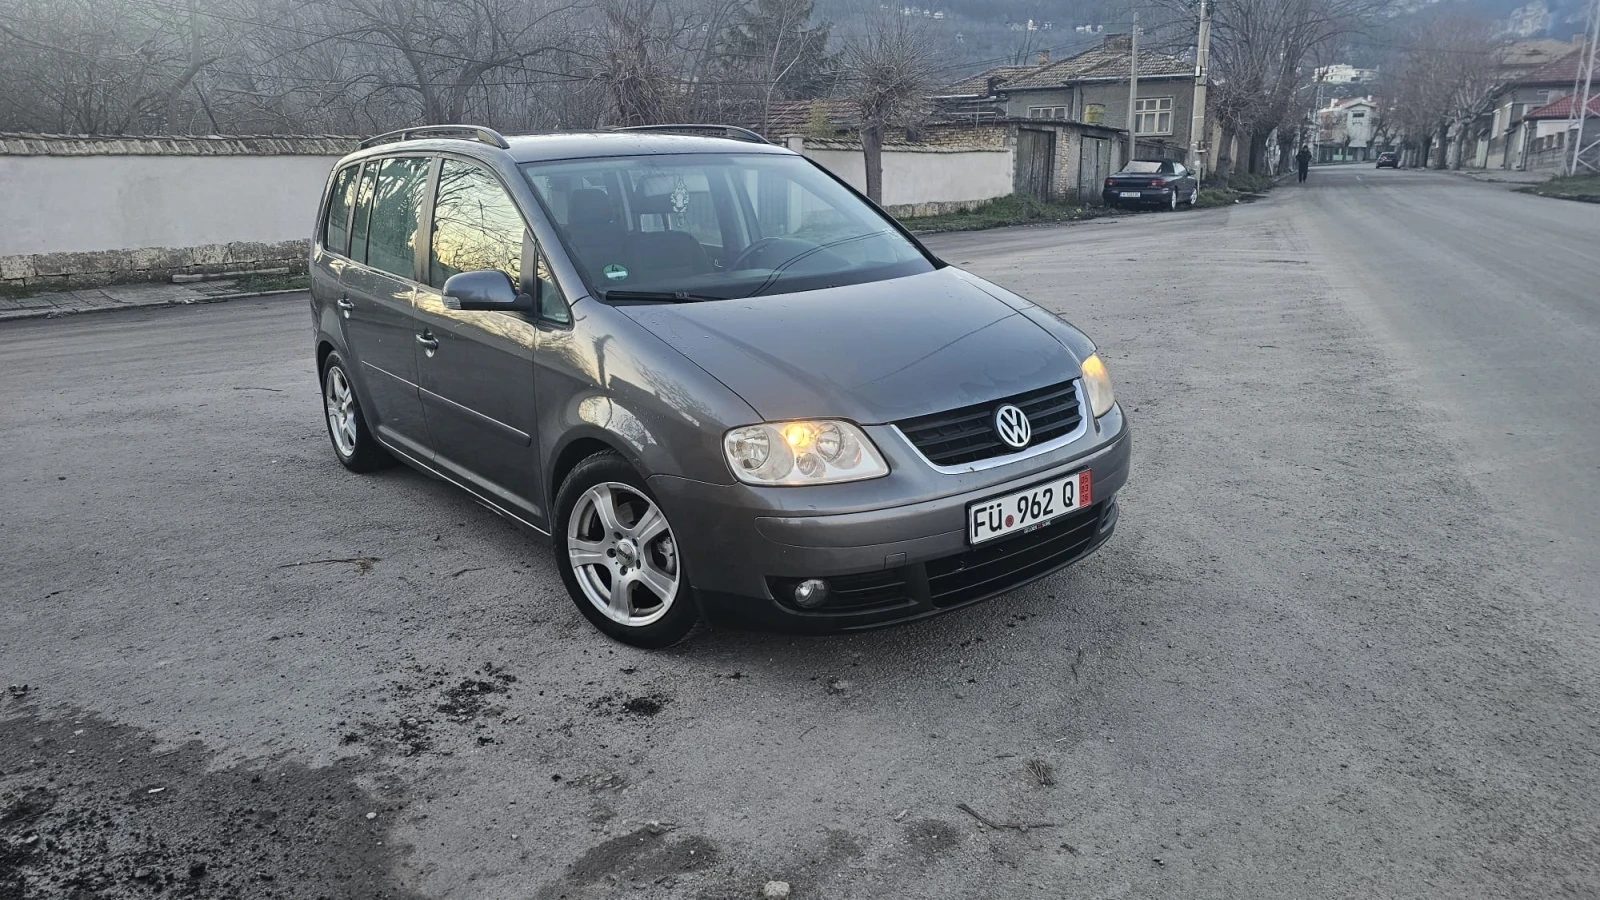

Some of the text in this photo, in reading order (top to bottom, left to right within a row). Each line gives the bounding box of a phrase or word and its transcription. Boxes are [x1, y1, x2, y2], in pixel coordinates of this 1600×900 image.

[996, 405, 1030, 447] VW
[973, 503, 1003, 537] FÜ
[1017, 487, 1053, 523] 962
[1063, 480, 1074, 507] Q
